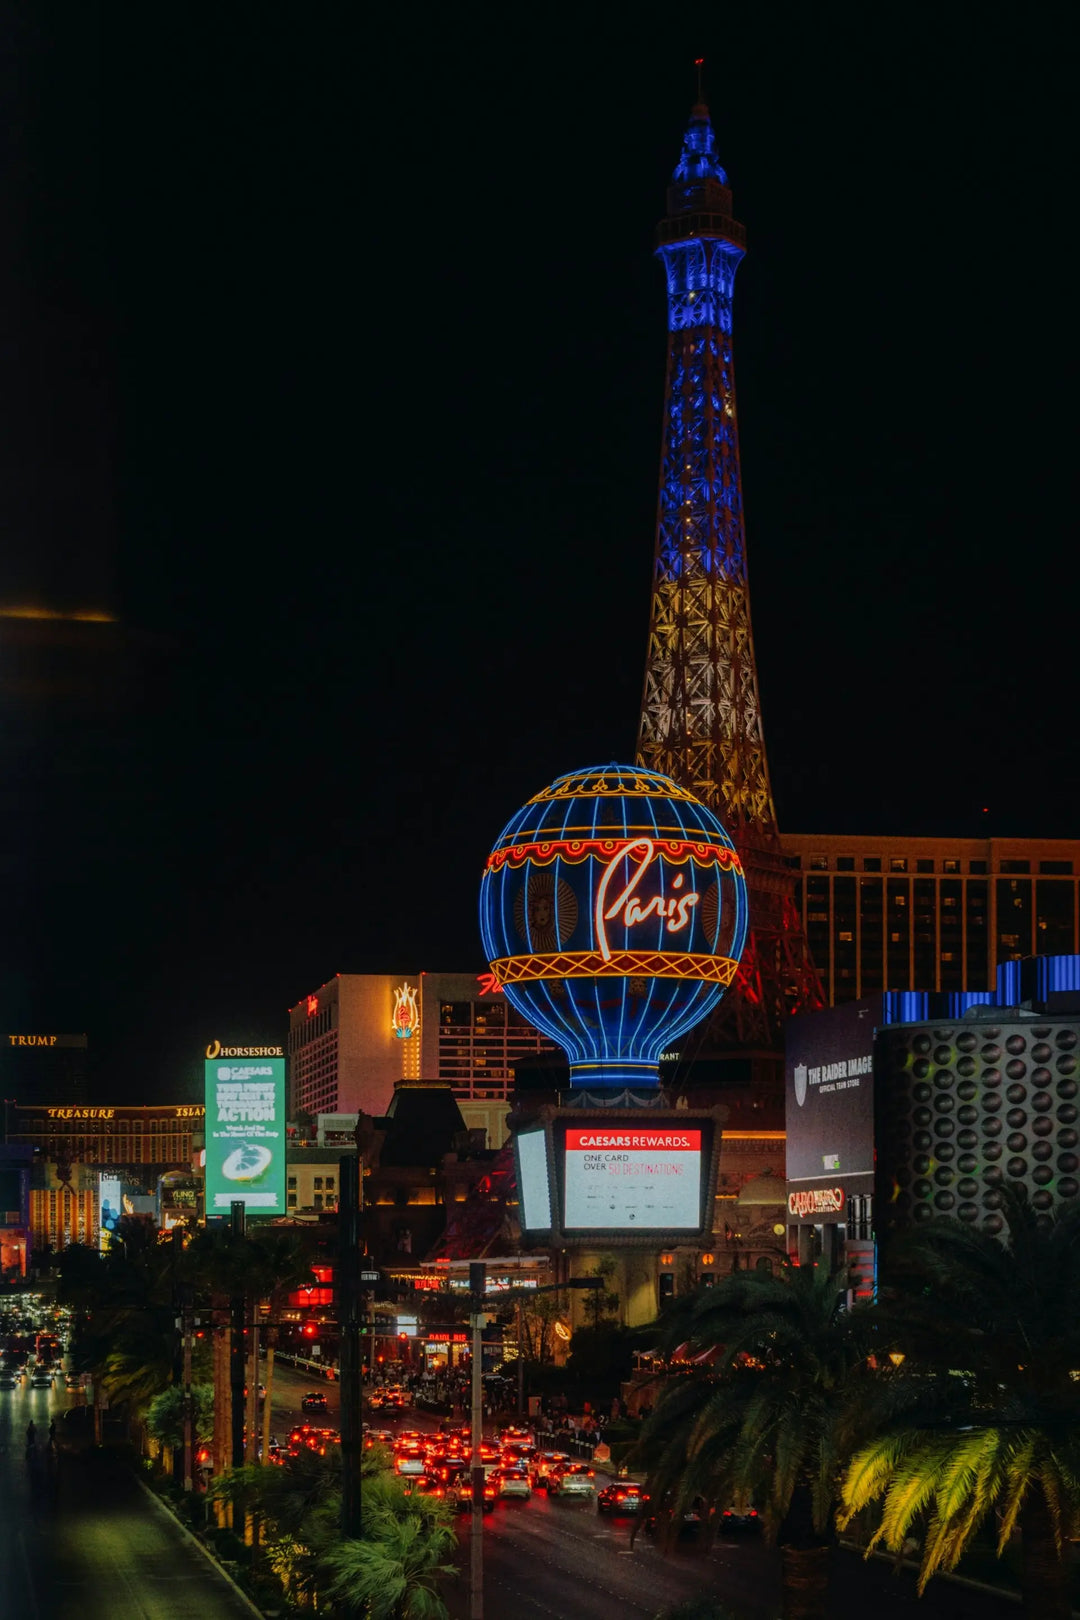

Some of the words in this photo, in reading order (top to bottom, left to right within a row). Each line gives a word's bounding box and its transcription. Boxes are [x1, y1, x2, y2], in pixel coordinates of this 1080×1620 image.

[596, 837, 699, 962] Paris
[9, 1035, 57, 1047] TRUMP
[220, 1046, 283, 1057] HORSESHOE
[808, 1066, 821, 1085] THE
[822, 1061, 848, 1083] RAIDER
[848, 1055, 873, 1077] IMAGE
[47, 1108, 115, 1120] TREASURE
[217, 1107, 276, 1122] ACTION
[579, 1136, 631, 1147] CAESARS
[583, 1154, 602, 1162] ONE
[604, 1154, 629, 1162] CARD
[583, 1162, 607, 1171] OVER
[608, 1163, 621, 1175] 50
[623, 1162, 684, 1175] DESTINATIONS
